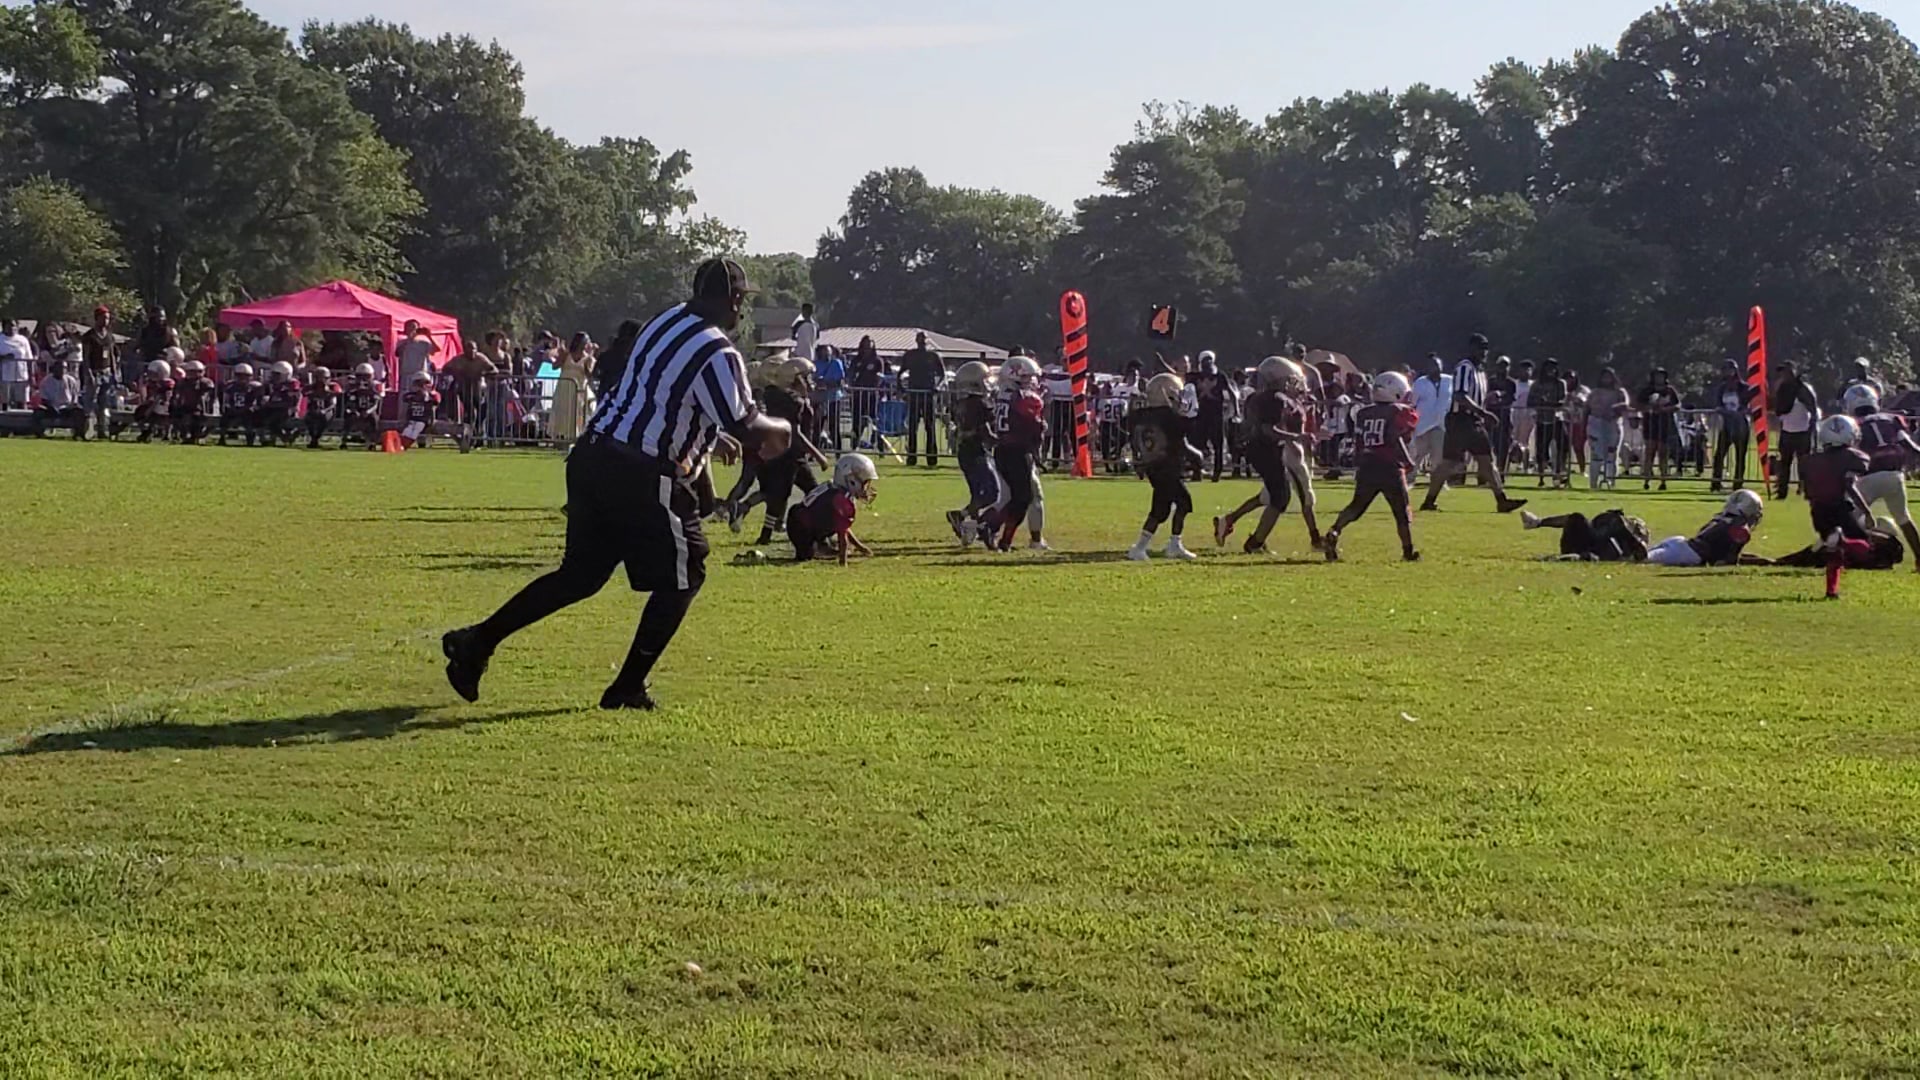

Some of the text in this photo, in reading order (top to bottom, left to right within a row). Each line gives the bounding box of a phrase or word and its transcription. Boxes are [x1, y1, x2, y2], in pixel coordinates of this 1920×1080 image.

[1152, 308, 1170, 334] 4
[1362, 418, 1385, 447] 29
[1870, 421, 1888, 447] 1
